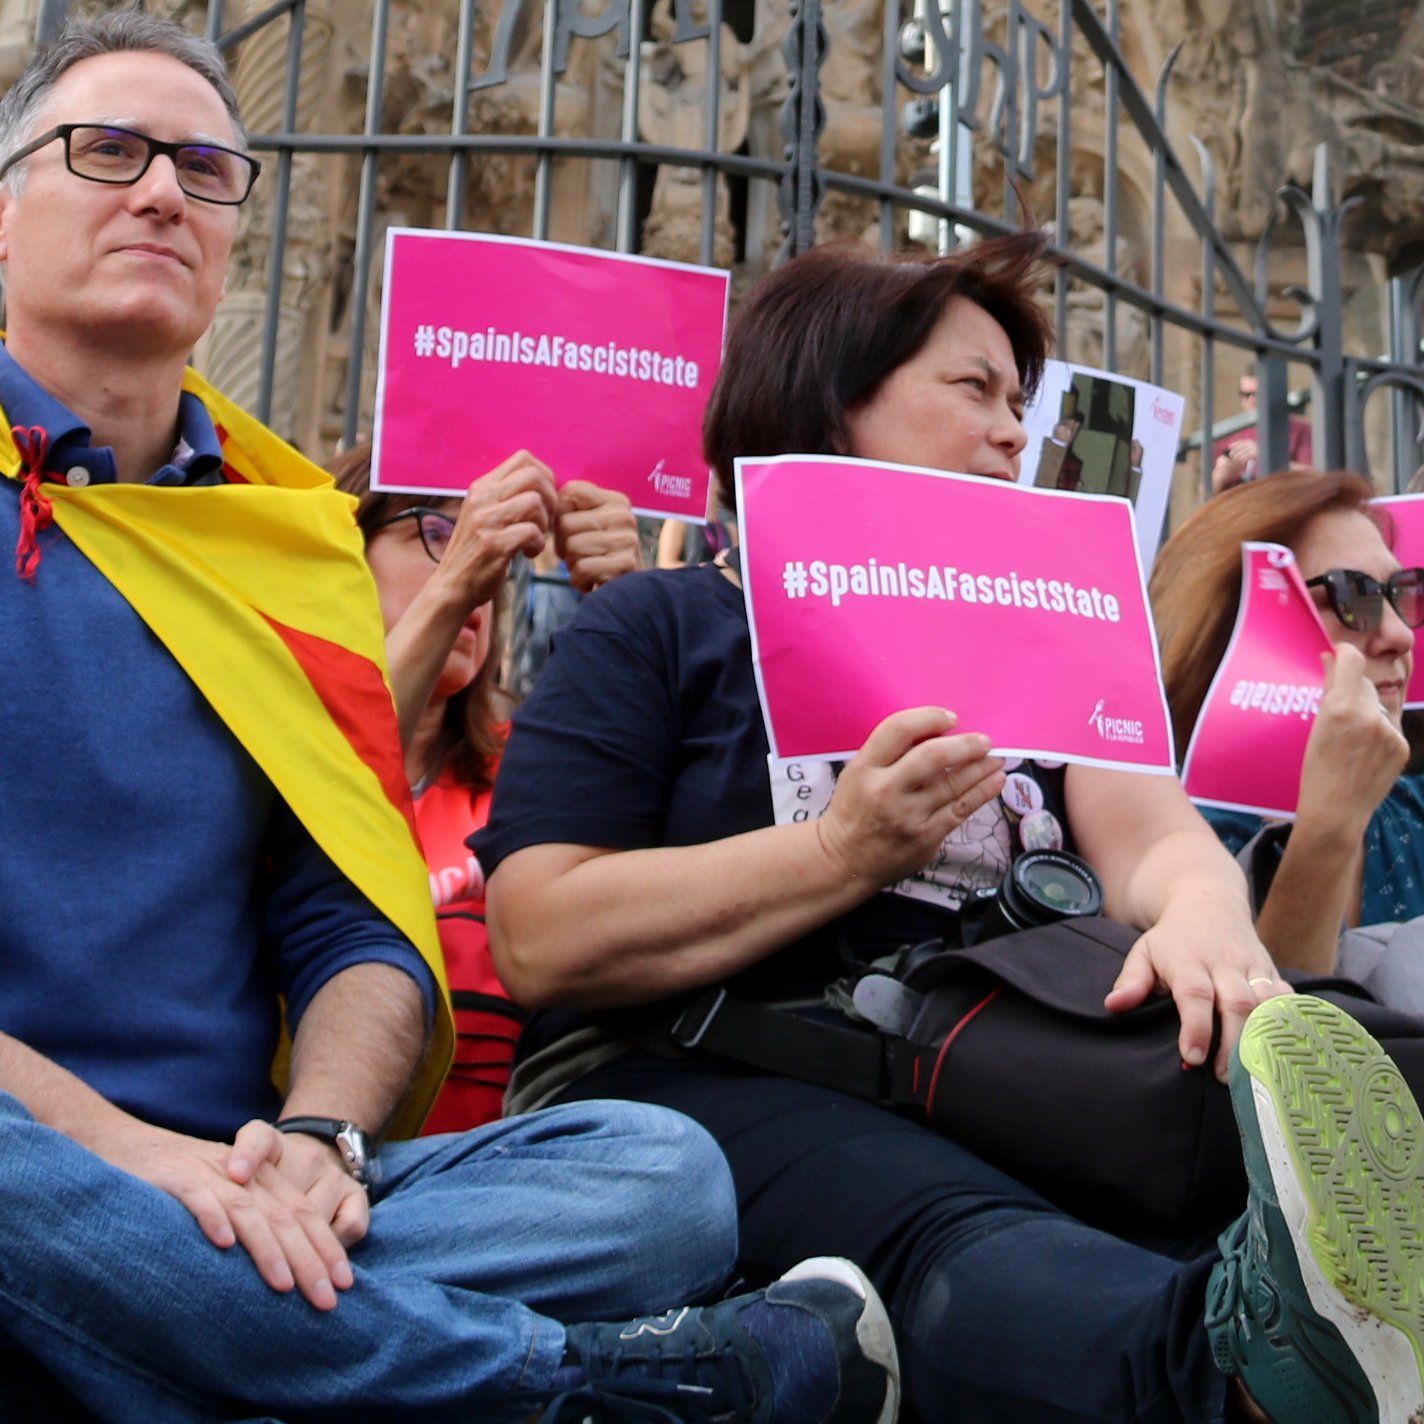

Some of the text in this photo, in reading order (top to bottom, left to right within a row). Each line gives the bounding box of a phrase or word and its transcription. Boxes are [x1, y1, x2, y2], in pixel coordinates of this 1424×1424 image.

[414, 324, 699, 389] #SpainIsAFascistState
[661, 474, 692, 491] PICNIC
[782, 557, 1121, 623] #SpainIsAFascistState
[1105, 717, 1143, 736] PICNIC
